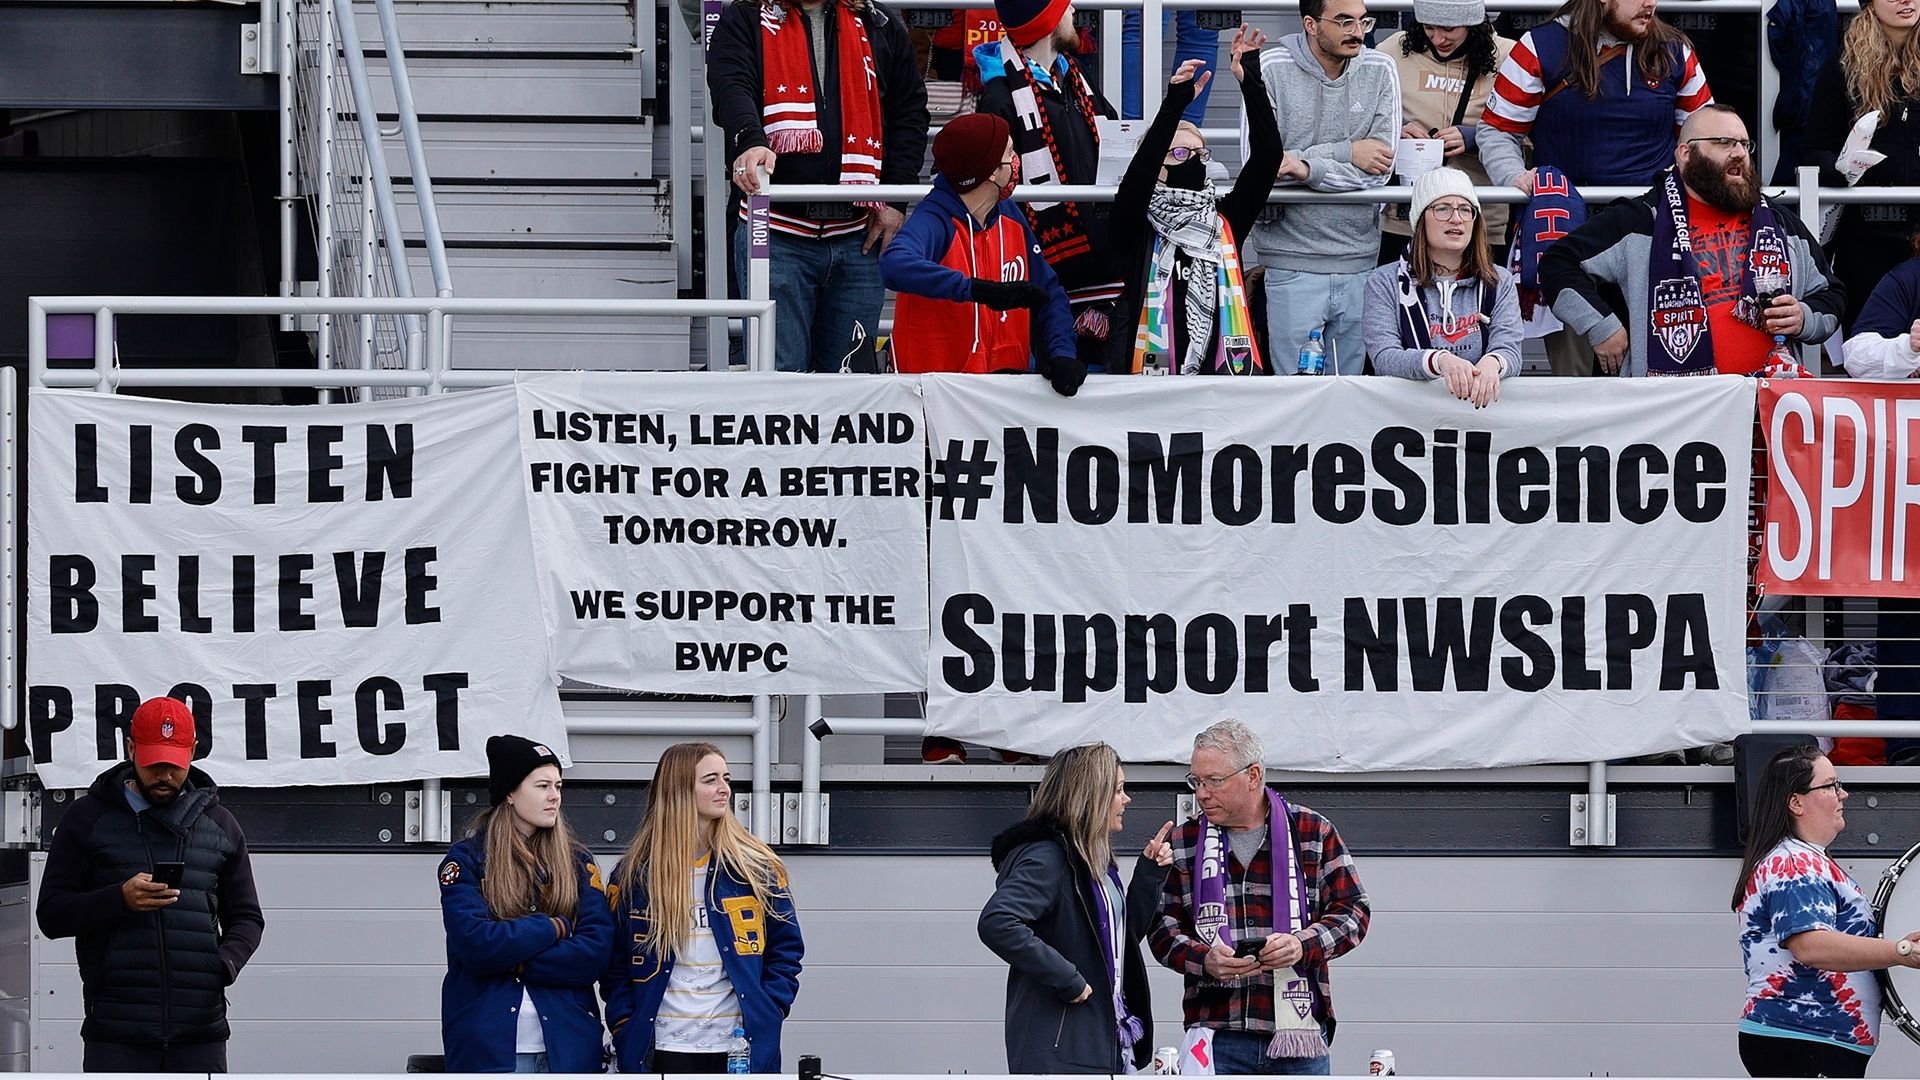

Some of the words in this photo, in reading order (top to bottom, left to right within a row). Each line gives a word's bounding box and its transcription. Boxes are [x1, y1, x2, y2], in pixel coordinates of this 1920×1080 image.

[1425, 74, 1474, 93] NWS
[752, 207, 768, 217] A
[1533, 172, 1570, 285] HE
[752, 220, 768, 246] ROW
[533, 410, 677, 452] LISTEN,
[690, 414, 820, 446] LEARN
[831, 413, 915, 445] AND
[75, 424, 414, 506] LISTEN
[531, 463, 640, 495] FIGHT
[652, 467, 730, 498] FOR
[741, 468, 768, 498] A
[780, 466, 920, 498] BETTER
[933, 425, 1727, 527] #NoMoreSilence
[604, 515, 848, 548] TOMORROW.
[50, 547, 442, 635] BELIEVE
[570, 590, 626, 620] WE
[635, 591, 816, 623] SUPPORT
[825, 595, 896, 626] THE
[676, 642, 788, 673] BWPC
[941, 590, 1320, 704] Support
[1344, 593, 1720, 692] NWSLPA
[29, 673, 469, 765] PROTECT
